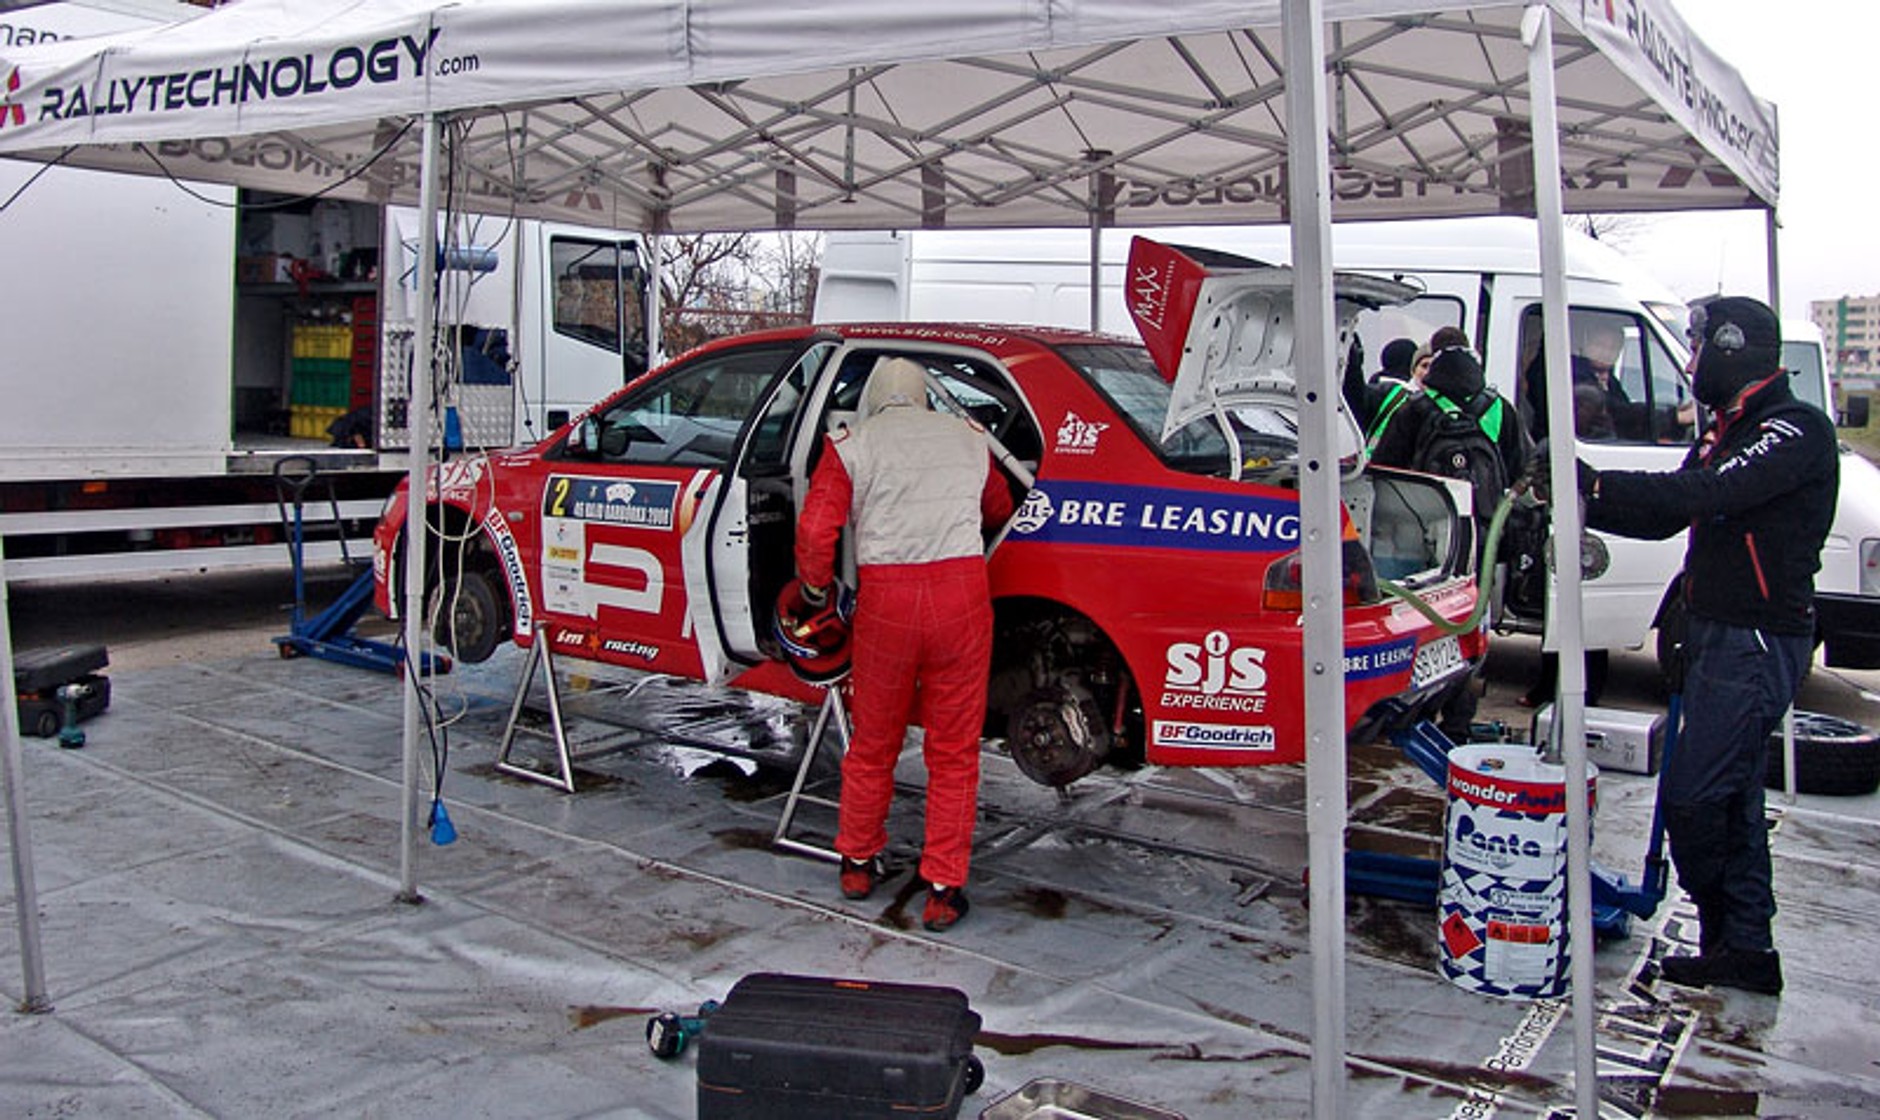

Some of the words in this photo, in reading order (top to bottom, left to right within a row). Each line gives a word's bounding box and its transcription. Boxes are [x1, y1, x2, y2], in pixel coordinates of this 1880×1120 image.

[1134, 265, 1163, 330] MAX
[551, 478, 570, 517] 2
[1058, 499, 1127, 527] BRE
[1139, 504, 1300, 541] LEASING
[488, 511, 531, 627] BFGoodrich
[604, 640, 659, 660] racing
[1342, 655, 1370, 673] BRE
[1373, 644, 1414, 669] LEASING
[1159, 692, 1267, 713] EXPERIENCE
[1158, 724, 1273, 745] BFGoodrich
